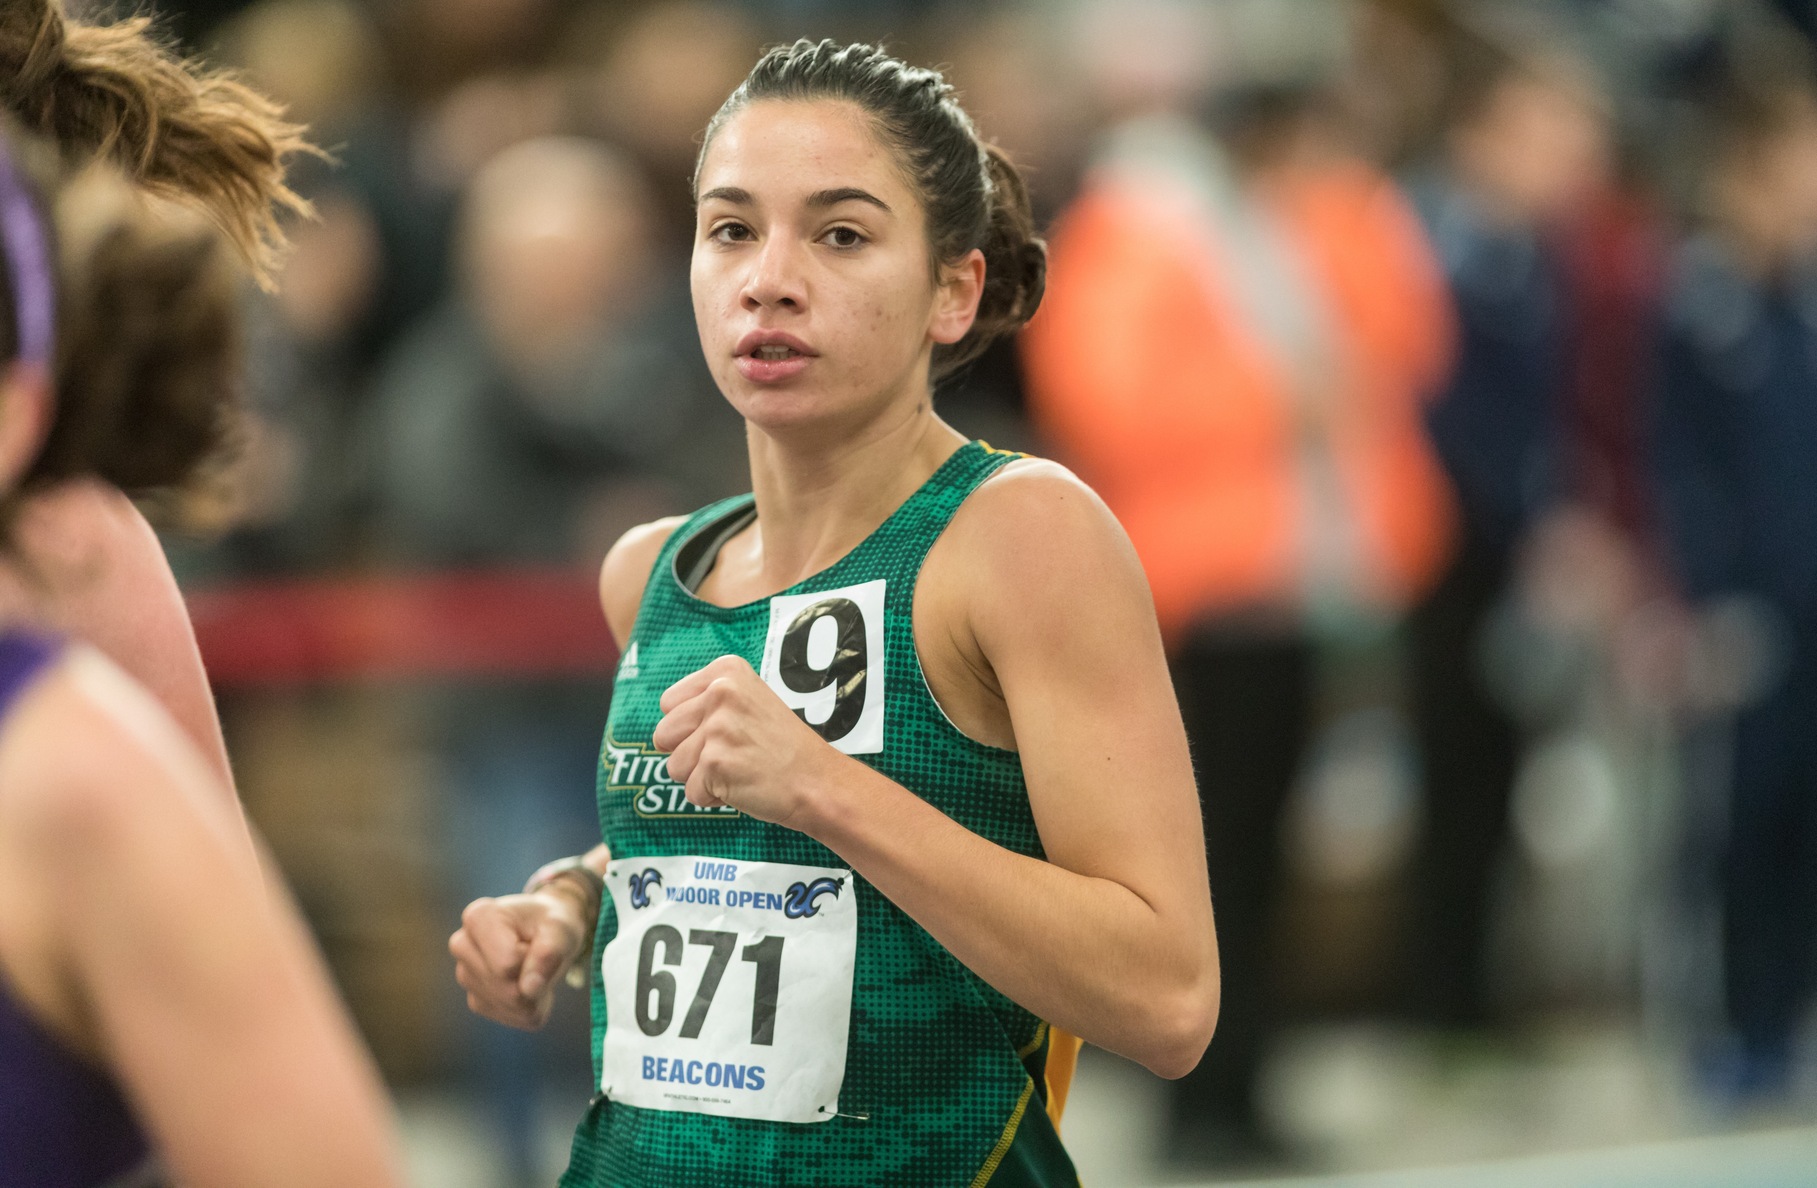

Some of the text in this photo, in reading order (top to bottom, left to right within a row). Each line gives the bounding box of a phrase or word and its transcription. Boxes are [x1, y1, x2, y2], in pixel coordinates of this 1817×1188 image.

[780, 598, 867, 743] 9
[607, 741, 674, 783] FITC
[694, 862, 738, 882] UMB
[726, 890, 783, 911] OPEN
[635, 924, 785, 1046] 671
[642, 1055, 766, 1091] BEACONS
